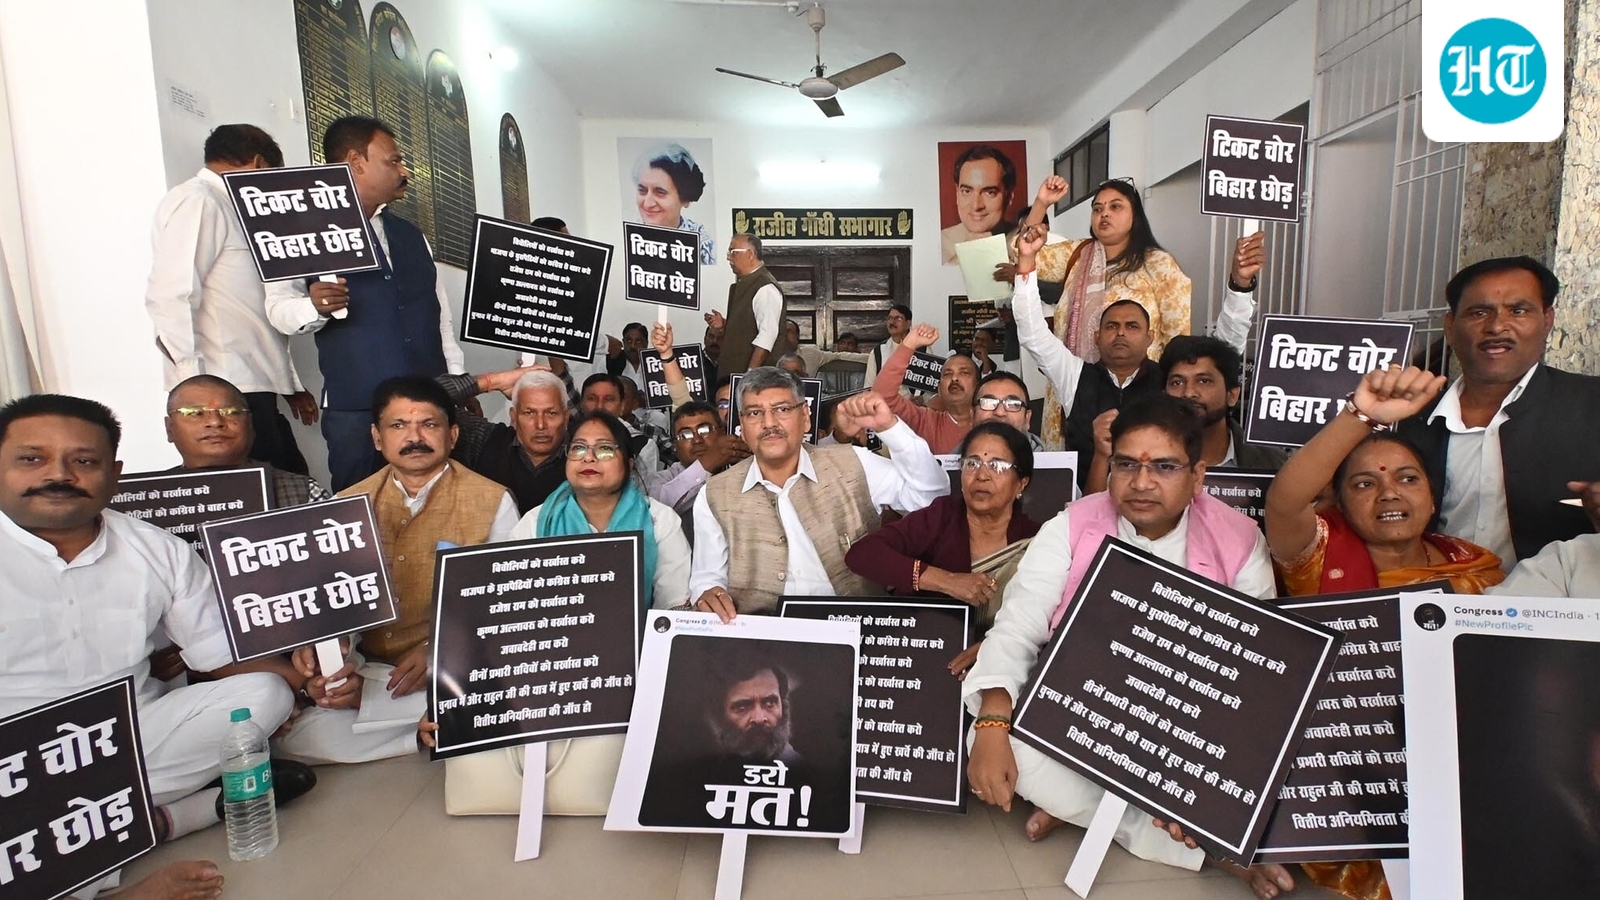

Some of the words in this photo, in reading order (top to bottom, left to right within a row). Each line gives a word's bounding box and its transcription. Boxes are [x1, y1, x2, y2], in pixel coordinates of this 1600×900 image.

[1213, 129, 1261, 160] टिकट
[1265, 135, 1295, 163] चोर
[239, 186, 308, 217] टिकट
[308, 180, 350, 209] चोर
[1209, 170, 1257, 200] बिहार
[1261, 175, 1294, 209] छोड़
[752, 211, 797, 237] राजीव
[839, 217, 892, 236] सभागार
[254, 231, 320, 261] बिहार
[320, 224, 364, 257] छोड़
[630, 233, 667, 258] टिकट
[670, 240, 694, 263] चोर
[630, 265, 667, 290] बिहार
[669, 271, 695, 299] छोड़
[679, 353, 698, 369] चोर
[910, 355, 929, 369] टिकट
[1269, 334, 1343, 372] टिकट
[905, 370, 924, 383] बिहार
[1259, 386, 1331, 424] बिहार
[148, 489, 160, 499] को
[193, 484, 210, 495] करो
[1210, 486, 1220, 495] को
[1248, 488, 1261, 497] करो
[220, 536, 309, 576] टिकट
[313, 518, 365, 554] चोर
[232, 593, 320, 633] बिहार
[323, 571, 380, 610] छोड़
[1193, 601, 1208, 615] को
[1239, 621, 1260, 637] करो
[1454, 606, 1502, 616] Congress
[1522, 611, 1583, 620] @INCIndia
[1110, 589, 1139, 609] भाजपा
[1137, 600, 1149, 612] के
[1188, 624, 1203, 638] को
[1232, 642, 1243, 656] से
[1242, 648, 1266, 666] बाहर
[1266, 658, 1287, 674] करो
[1357, 614, 1379, 629] करो
[1455, 620, 1533, 631] #NewProfilePic
[864, 634, 876, 645] को
[901, 635, 909, 647] से
[910, 638, 928, 648] बाहर
[929, 637, 944, 649] करो
[1131, 624, 1157, 643] राजेश
[1156, 636, 1173, 651] राम
[1172, 643, 1187, 657] को
[1219, 665, 1239, 681] करो
[1367, 640, 1379, 653] से
[1374, 664, 1396, 679] करो
[1124, 674, 1166, 701] जवाबदेही
[1165, 694, 1182, 709] तय
[1181, 702, 1201, 719] करो
[1173, 670, 1189, 685] को
[1221, 693, 1242, 710] करो
[1340, 694, 1357, 709] को
[1082, 679, 1106, 698] तीनों
[1102, 690, 1129, 710] प्रभारी
[1157, 718, 1172, 733] को
[1205, 742, 1226, 760] करो
[1352, 724, 1371, 736] तय
[1371, 720, 1395, 735] करो
[39, 722, 118, 775] चोर
[871, 741, 880, 755] में
[879, 745, 893, 759] हुए
[912, 745, 925, 759] की
[1037, 684, 1063, 703] चुनाव
[1061, 694, 1074, 708] में
[1069, 700, 1089, 717] और
[1088, 710, 1112, 730] राहुल
[1110, 722, 1125, 737] जी
[1124, 729, 1140, 745] की
[1157, 744, 1170, 760] में
[1164, 752, 1184, 768] हुए
[1203, 770, 1220, 787] की
[1242, 789, 1257, 805] हो
[1296, 752, 1327, 769] प्रभारी
[1364, 749, 1382, 764] को
[743, 760, 789, 786] डरो
[1146, 770, 1162, 787] की
[1183, 789, 1197, 805] हो
[1296, 784, 1326, 802] राहुल
[1327, 780, 1344, 796] जी
[1345, 779, 1363, 795] की
[1387, 778, 1399, 794] में
[49, 786, 134, 855] छोड़
[704, 784, 812, 827] मत!
